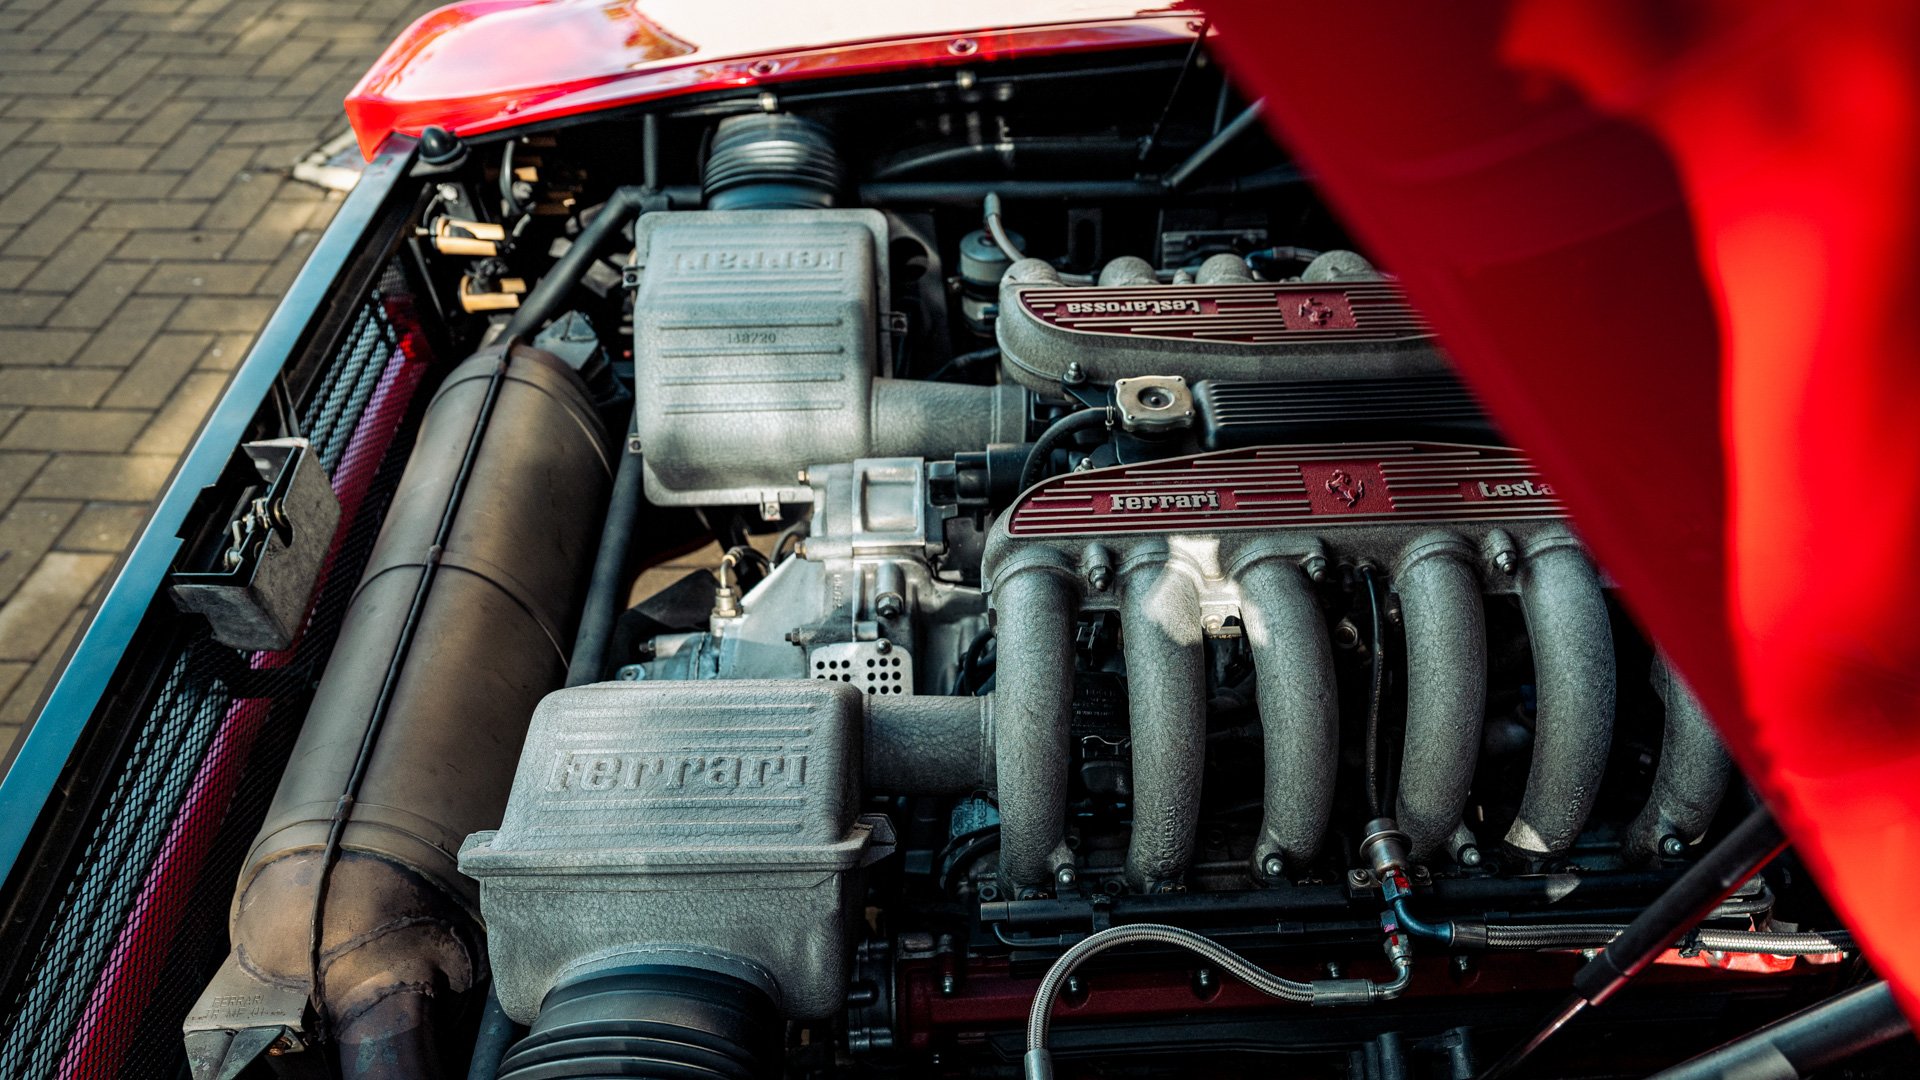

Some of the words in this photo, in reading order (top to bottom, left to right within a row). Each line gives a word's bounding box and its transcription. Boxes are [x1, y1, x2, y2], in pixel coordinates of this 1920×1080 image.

[1066, 300, 1200, 313] testarossa
[1110, 490, 1219, 511] Ferrari
[545, 745, 809, 793] Ferrari
